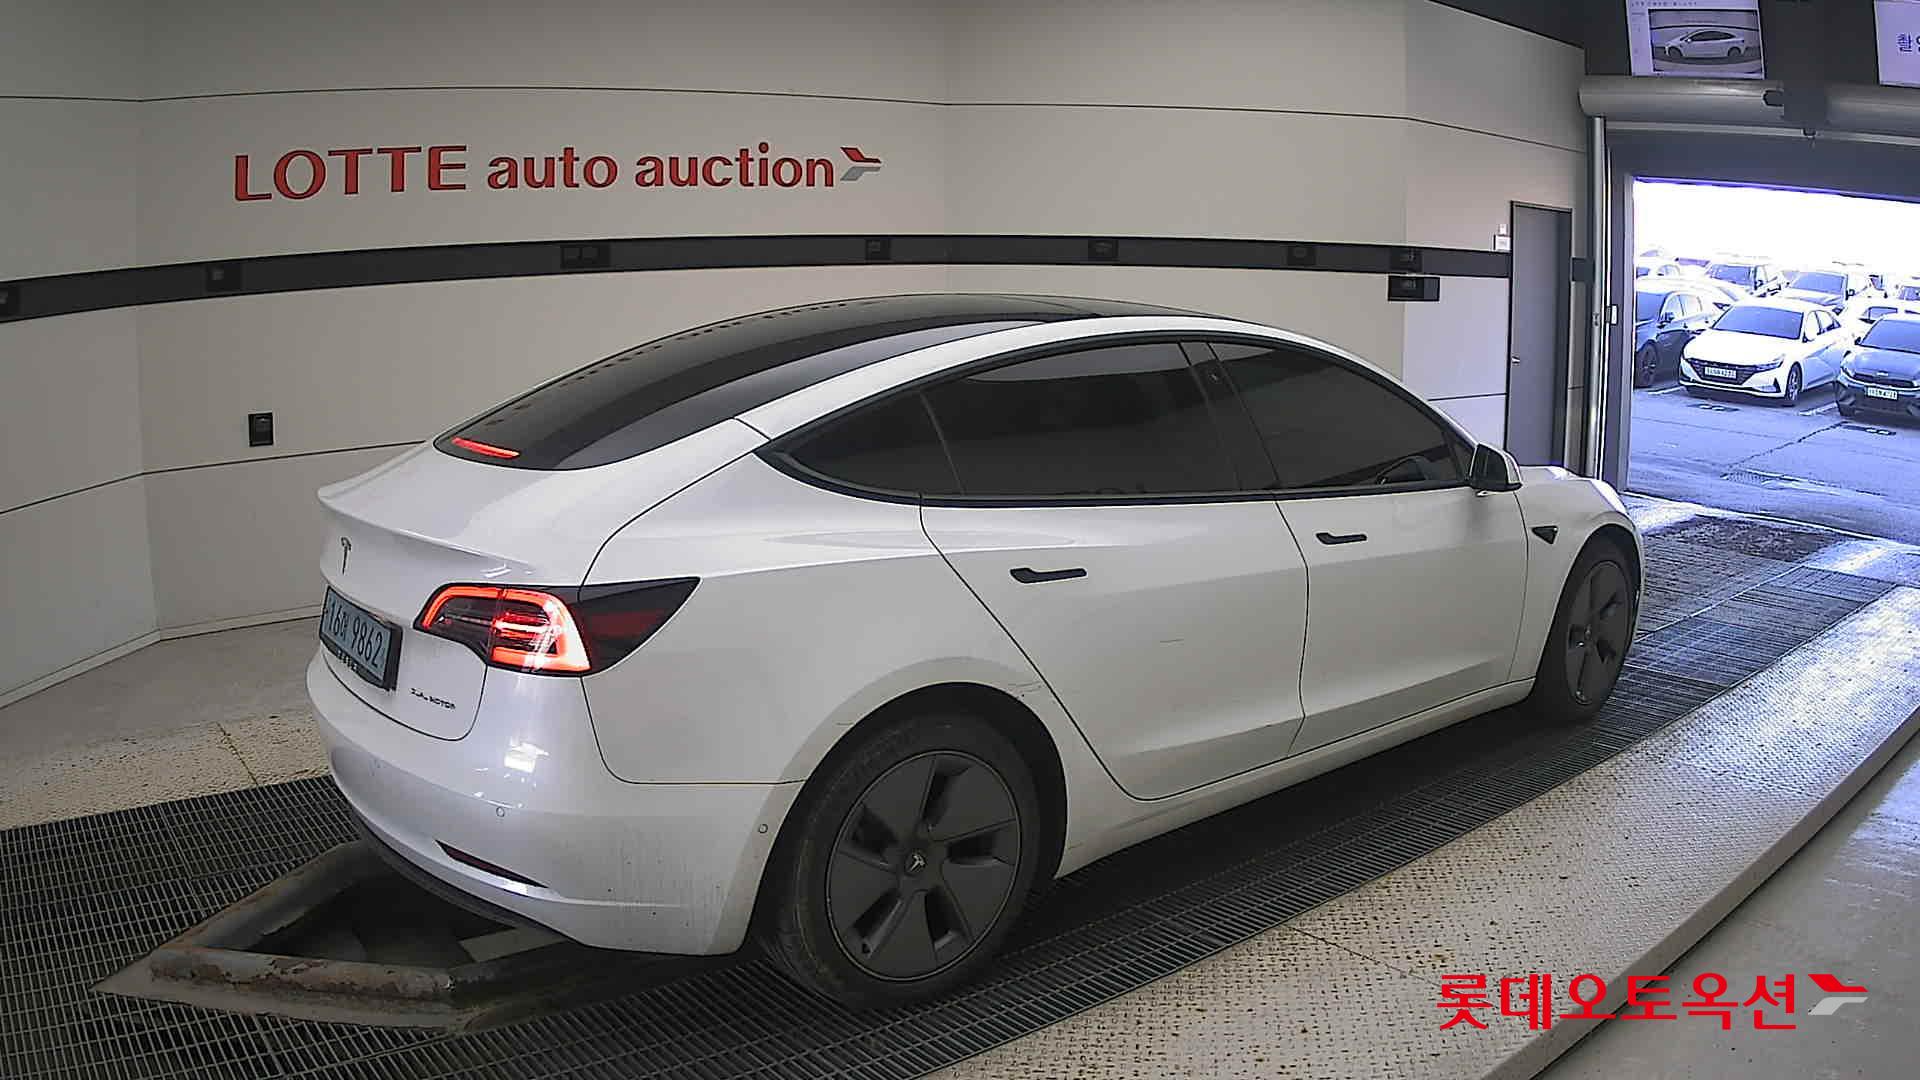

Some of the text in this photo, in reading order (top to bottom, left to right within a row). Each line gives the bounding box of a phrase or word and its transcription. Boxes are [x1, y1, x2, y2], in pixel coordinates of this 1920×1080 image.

[235, 142, 835, 201] LOTTE auto auction
[351, 616, 383, 669] 9862
